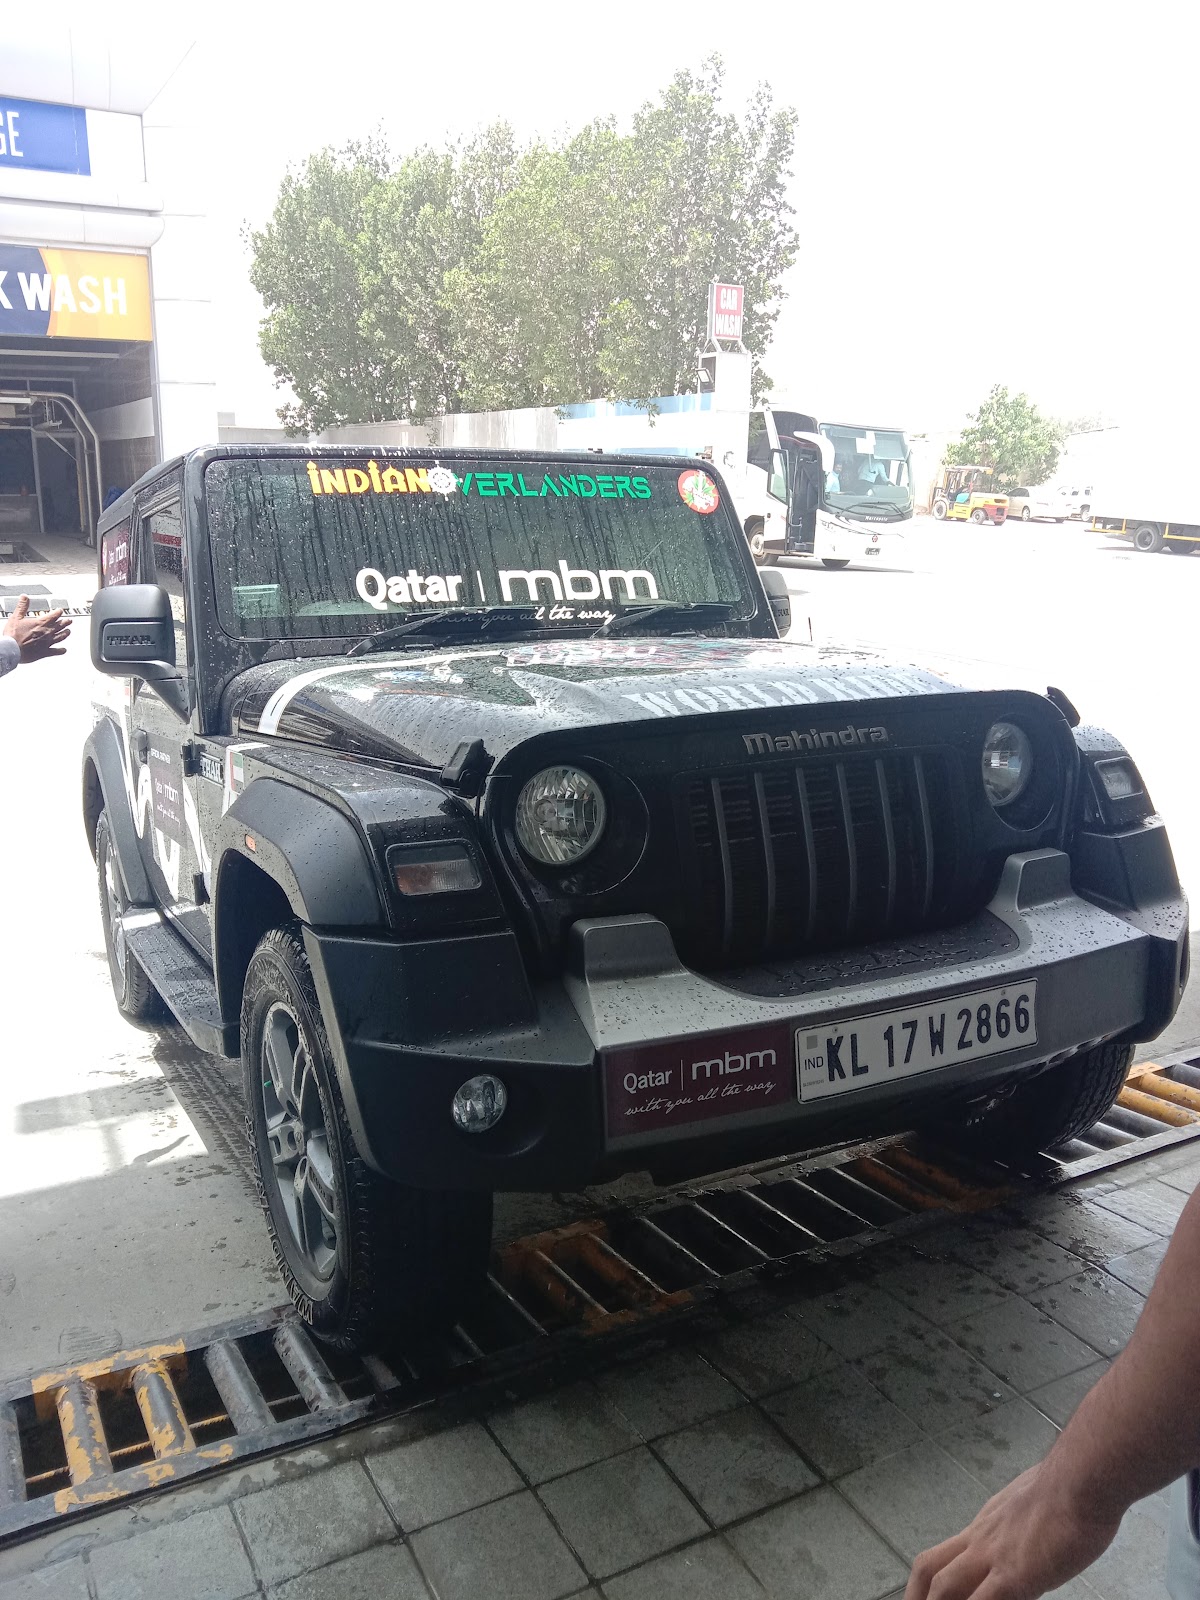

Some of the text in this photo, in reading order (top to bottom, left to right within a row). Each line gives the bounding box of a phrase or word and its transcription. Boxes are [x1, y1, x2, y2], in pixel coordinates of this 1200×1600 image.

[17, 272, 128, 316] WASH
[720, 287, 738, 311] CAR
[715, 313, 741, 338] WASH
[355, 559, 660, 611] Qatar mbm
[549, 604, 575, 621] the
[577, 607, 617, 626] way
[106, 634, 156, 647] THAR
[621, 680, 820, 718] WORLD
[741, 724, 890, 755] Mahindra
[827, 993, 1031, 1082] KL 17 W 2866
[623, 1048, 777, 1094] Qatar mbm
[804, 1056, 824, 1071] IND
[624, 1080, 777, 1116] with you all the way
